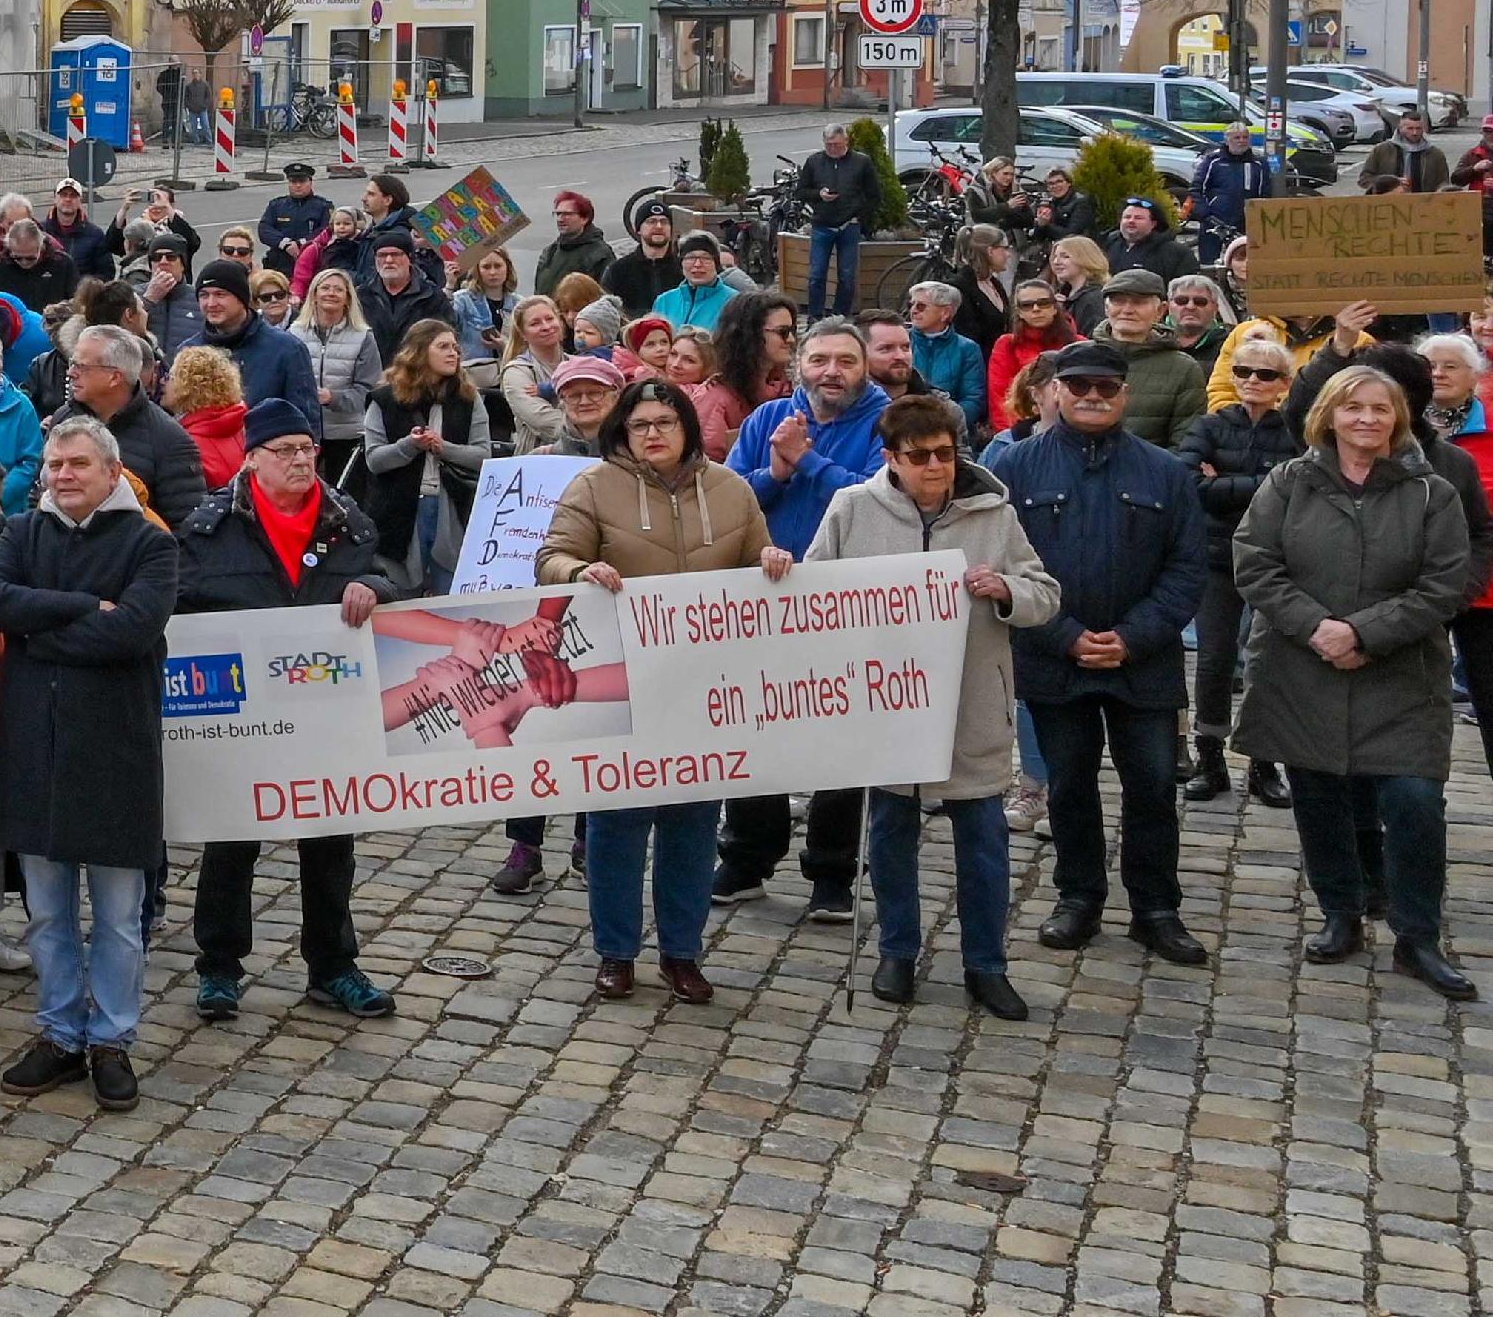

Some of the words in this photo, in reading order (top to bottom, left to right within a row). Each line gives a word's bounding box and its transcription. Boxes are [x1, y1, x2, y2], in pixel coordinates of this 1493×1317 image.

[864, 43, 896, 60] 150
[900, 48, 918, 60] m
[1332, 232, 1461, 258] RECHTE
[1253, 273, 1301, 289] STATT
[1316, 271, 1387, 287] RECHTE
[1393, 270, 1483, 286] MENSCHEN
[630, 593, 675, 647] Wir
[685, 588, 771, 644] stehen
[777, 583, 920, 635] zusammen
[925, 569, 959, 621] für
[269, 651, 347, 678] STADT
[287, 662, 362, 685] ROTH
[163, 667, 188, 697] ist
[450, 649, 525, 718] wieder
[707, 673, 746, 727] ein
[755, 661, 855, 731] „buntes“
[865, 658, 930, 712] Roth
[253, 765, 514, 821] DEMOkratie
[530, 759, 560, 798] &
[572, 749, 750, 795] Toleranz
